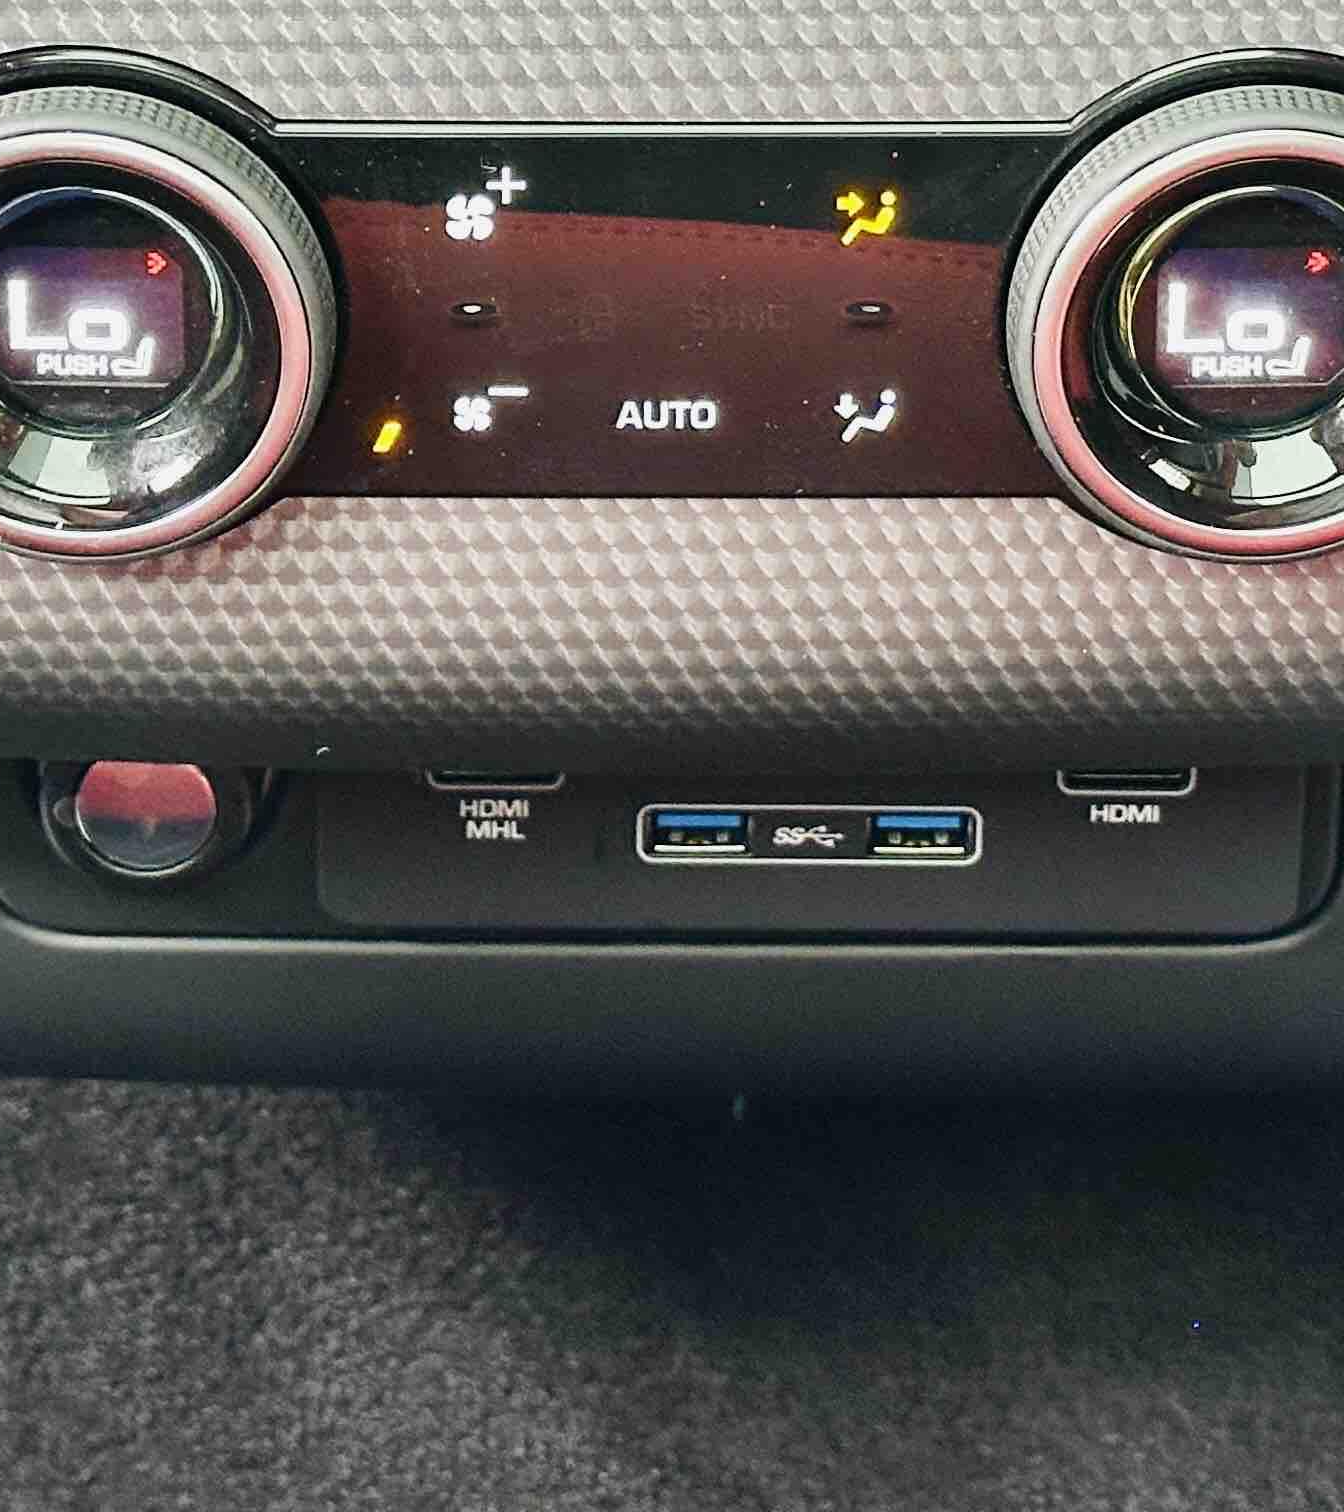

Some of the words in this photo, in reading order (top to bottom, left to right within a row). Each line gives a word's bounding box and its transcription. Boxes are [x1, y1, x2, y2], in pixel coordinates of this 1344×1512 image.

[6, 278, 131, 351] Lo
[1166, 281, 1287, 353] Lo
[35, 353, 109, 376] PUSH
[1191, 355, 1263, 377] PUSH
[615, 400, 717, 430] AUTO
[459, 798, 530, 818] HDMI
[1089, 803, 1161, 824] HDMI
[465, 819, 527, 840] MHL
